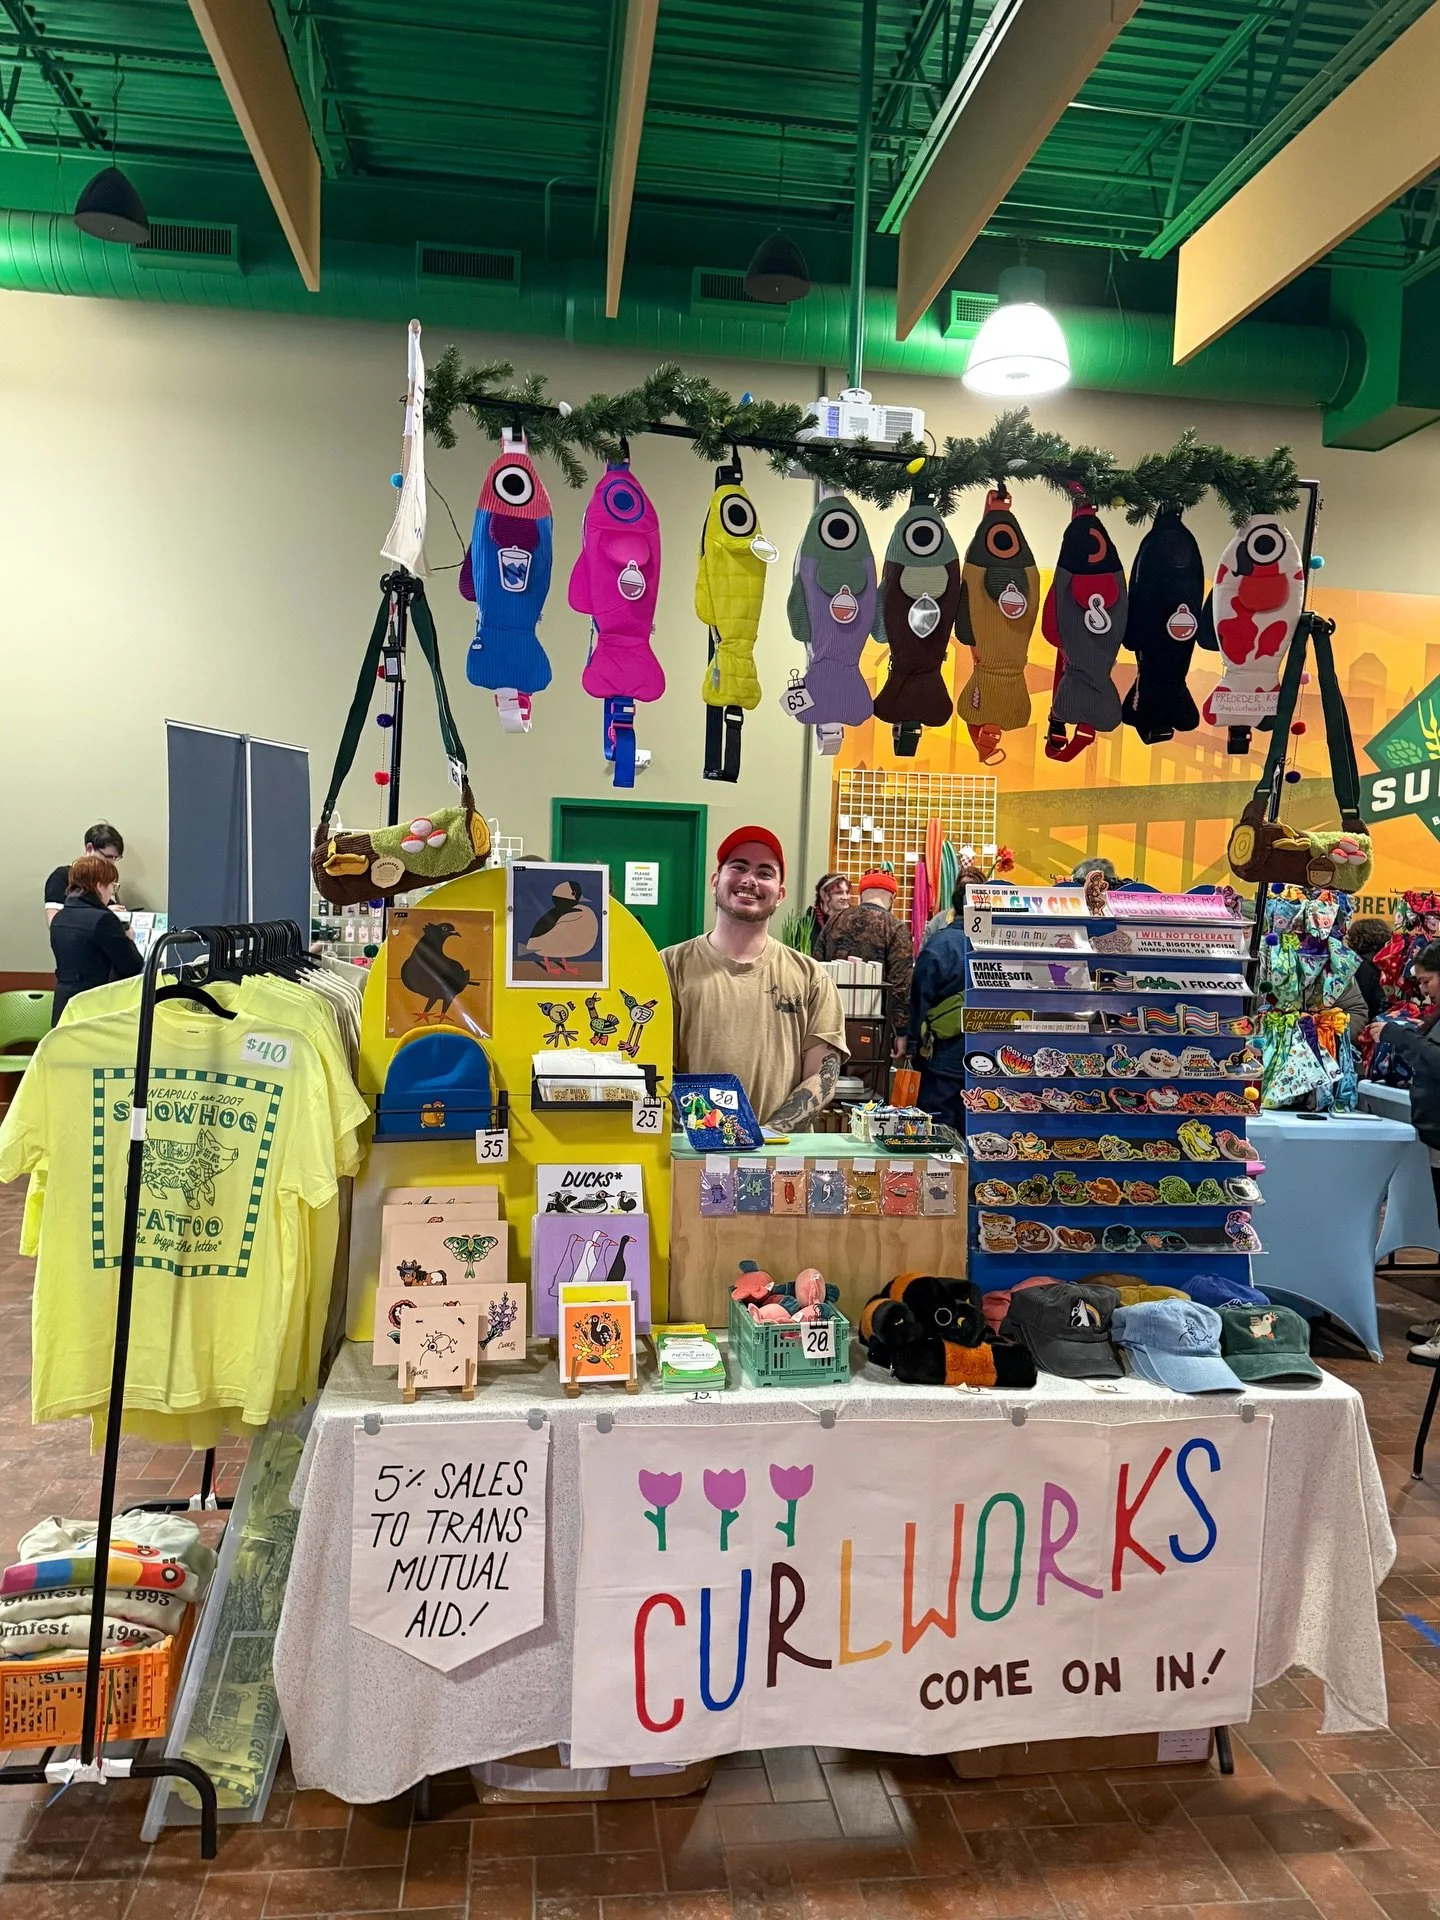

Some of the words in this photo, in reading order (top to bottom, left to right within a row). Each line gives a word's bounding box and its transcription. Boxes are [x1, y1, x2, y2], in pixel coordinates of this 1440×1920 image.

[1371, 766, 1440, 812] SU
[1009, 896, 1044, 913] GAY
[1141, 931, 1164, 939] WILL
[1188, 932, 1234, 940] TOLERATE
[972, 962, 1002, 971] MAKE
[974, 972, 1033, 981] MINNESOTA
[976, 980, 1011, 988] BIGGER
[1190, 980, 1244, 990] FROGOT
[972, 1011, 995, 1020] SHIT
[996, 1011, 1011, 1020] MY
[246, 1037, 287, 1063] $40
[128, 1088, 198, 1101] MNEAPOLIS
[214, 1094, 245, 1107] 2007
[636, 1109, 658, 1129] 25.
[481, 1139, 504, 1159] 35.
[175, 1239, 192, 1253] the
[375, 1465, 426, 1502] 5%
[434, 1459, 528, 1500] SALES
[371, 1511, 410, 1548] TO
[427, 1506, 529, 1545] TRANS
[387, 1551, 510, 1593] MUTUAL
[633, 1438, 1221, 1733] CURLWORKS
[0, 1622, 70, 1638] rmfest
[919, 1658, 1032, 1710] COME
[1061, 1656, 1122, 1696] ON
[1155, 1648, 1226, 1693] IN!
